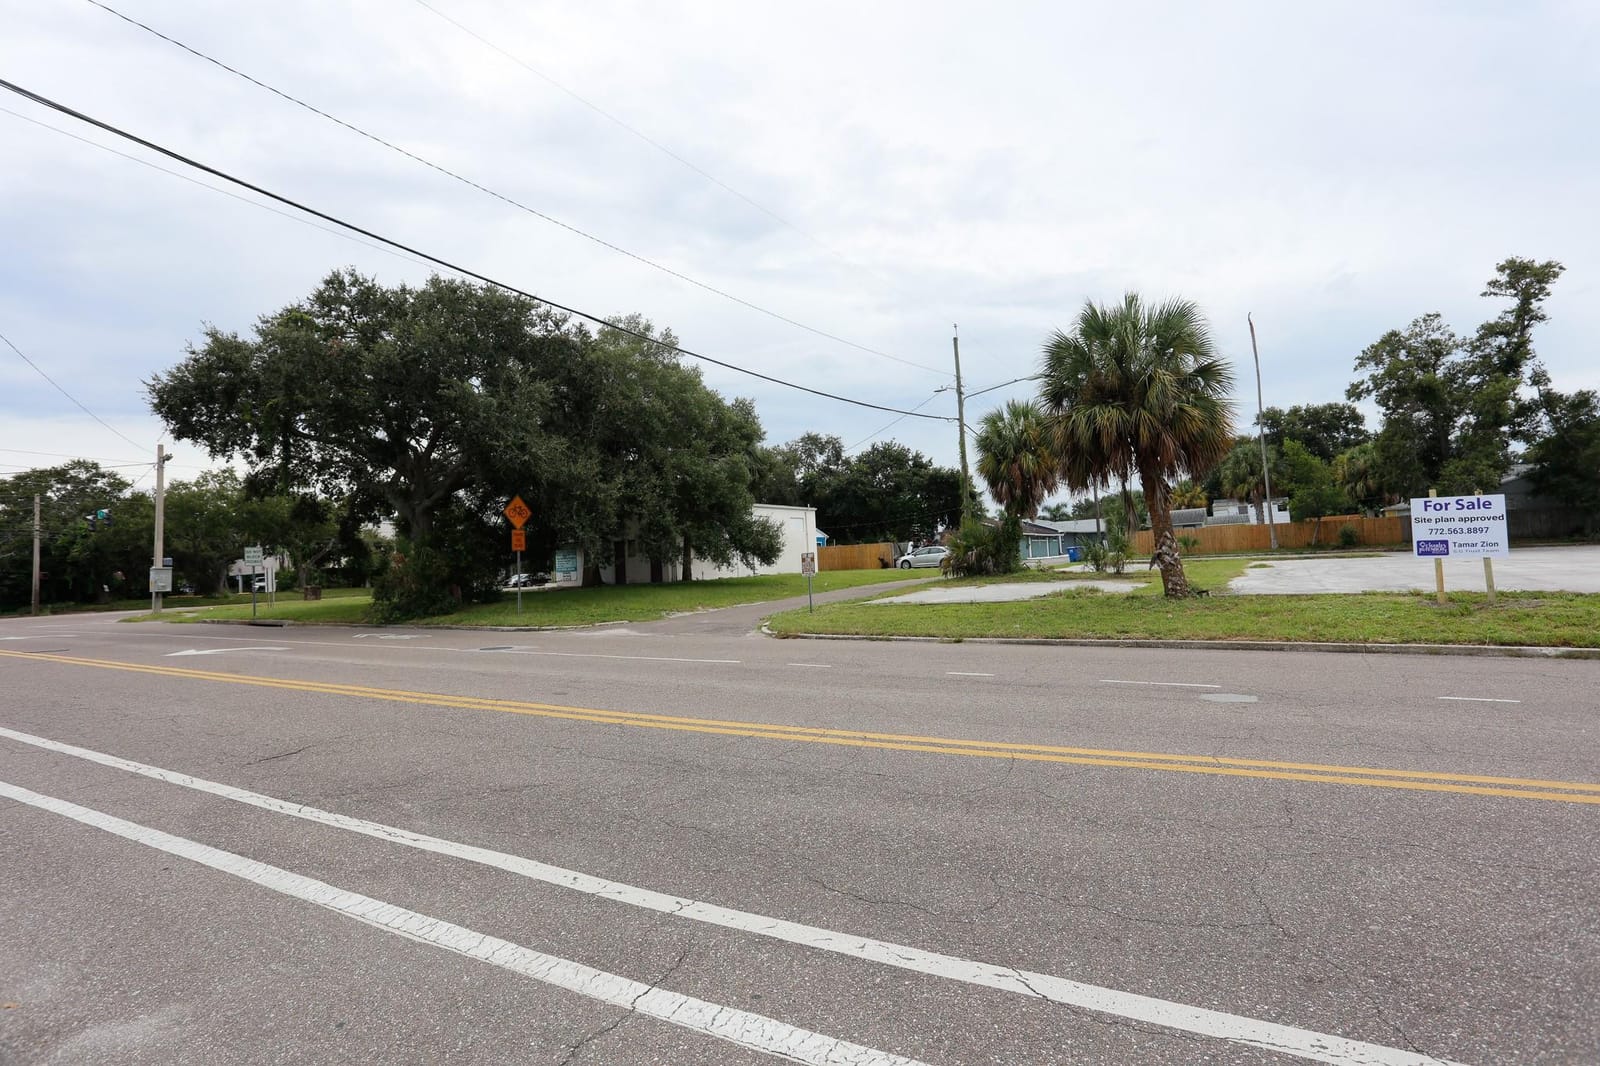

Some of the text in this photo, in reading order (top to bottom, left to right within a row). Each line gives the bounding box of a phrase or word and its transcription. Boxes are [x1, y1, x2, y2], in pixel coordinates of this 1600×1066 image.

[1424, 497, 1492, 512] For Sale
[1414, 514, 1505, 524] Site plan approved
[1428, 526, 1489, 535] 772.563.8897
